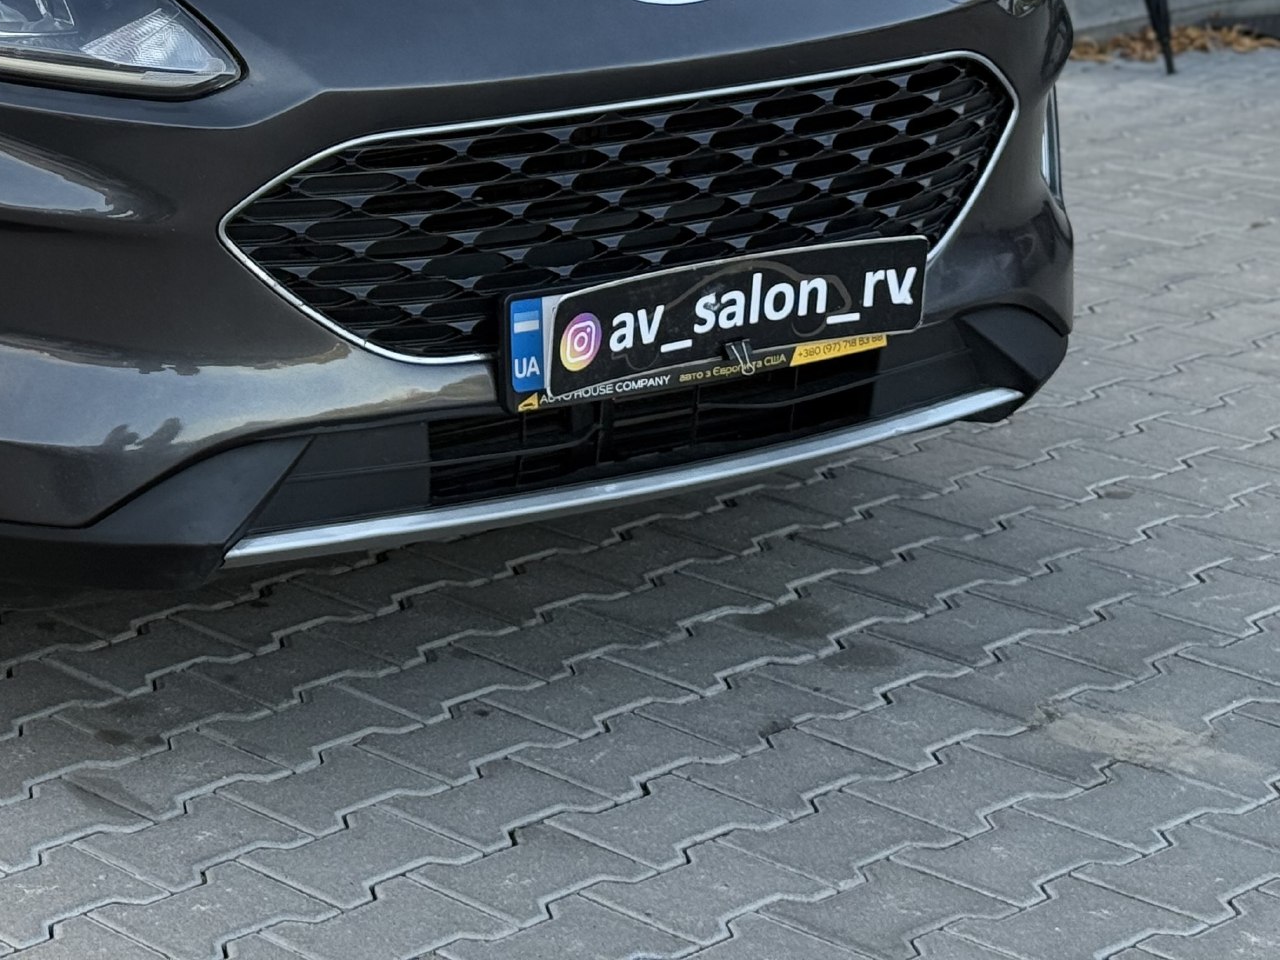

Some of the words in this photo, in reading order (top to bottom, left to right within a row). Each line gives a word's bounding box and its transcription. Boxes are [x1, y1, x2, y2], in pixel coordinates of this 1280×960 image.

[609, 266, 918, 354] av_salon_rv
[798, 346, 821, 358] +380
[823, 342, 841, 355] (97)
[514, 356, 541, 379] UA
[680, 371, 704, 382] авто
[764, 353, 787, 367] США
[615, 374, 671, 392] COMPANY
